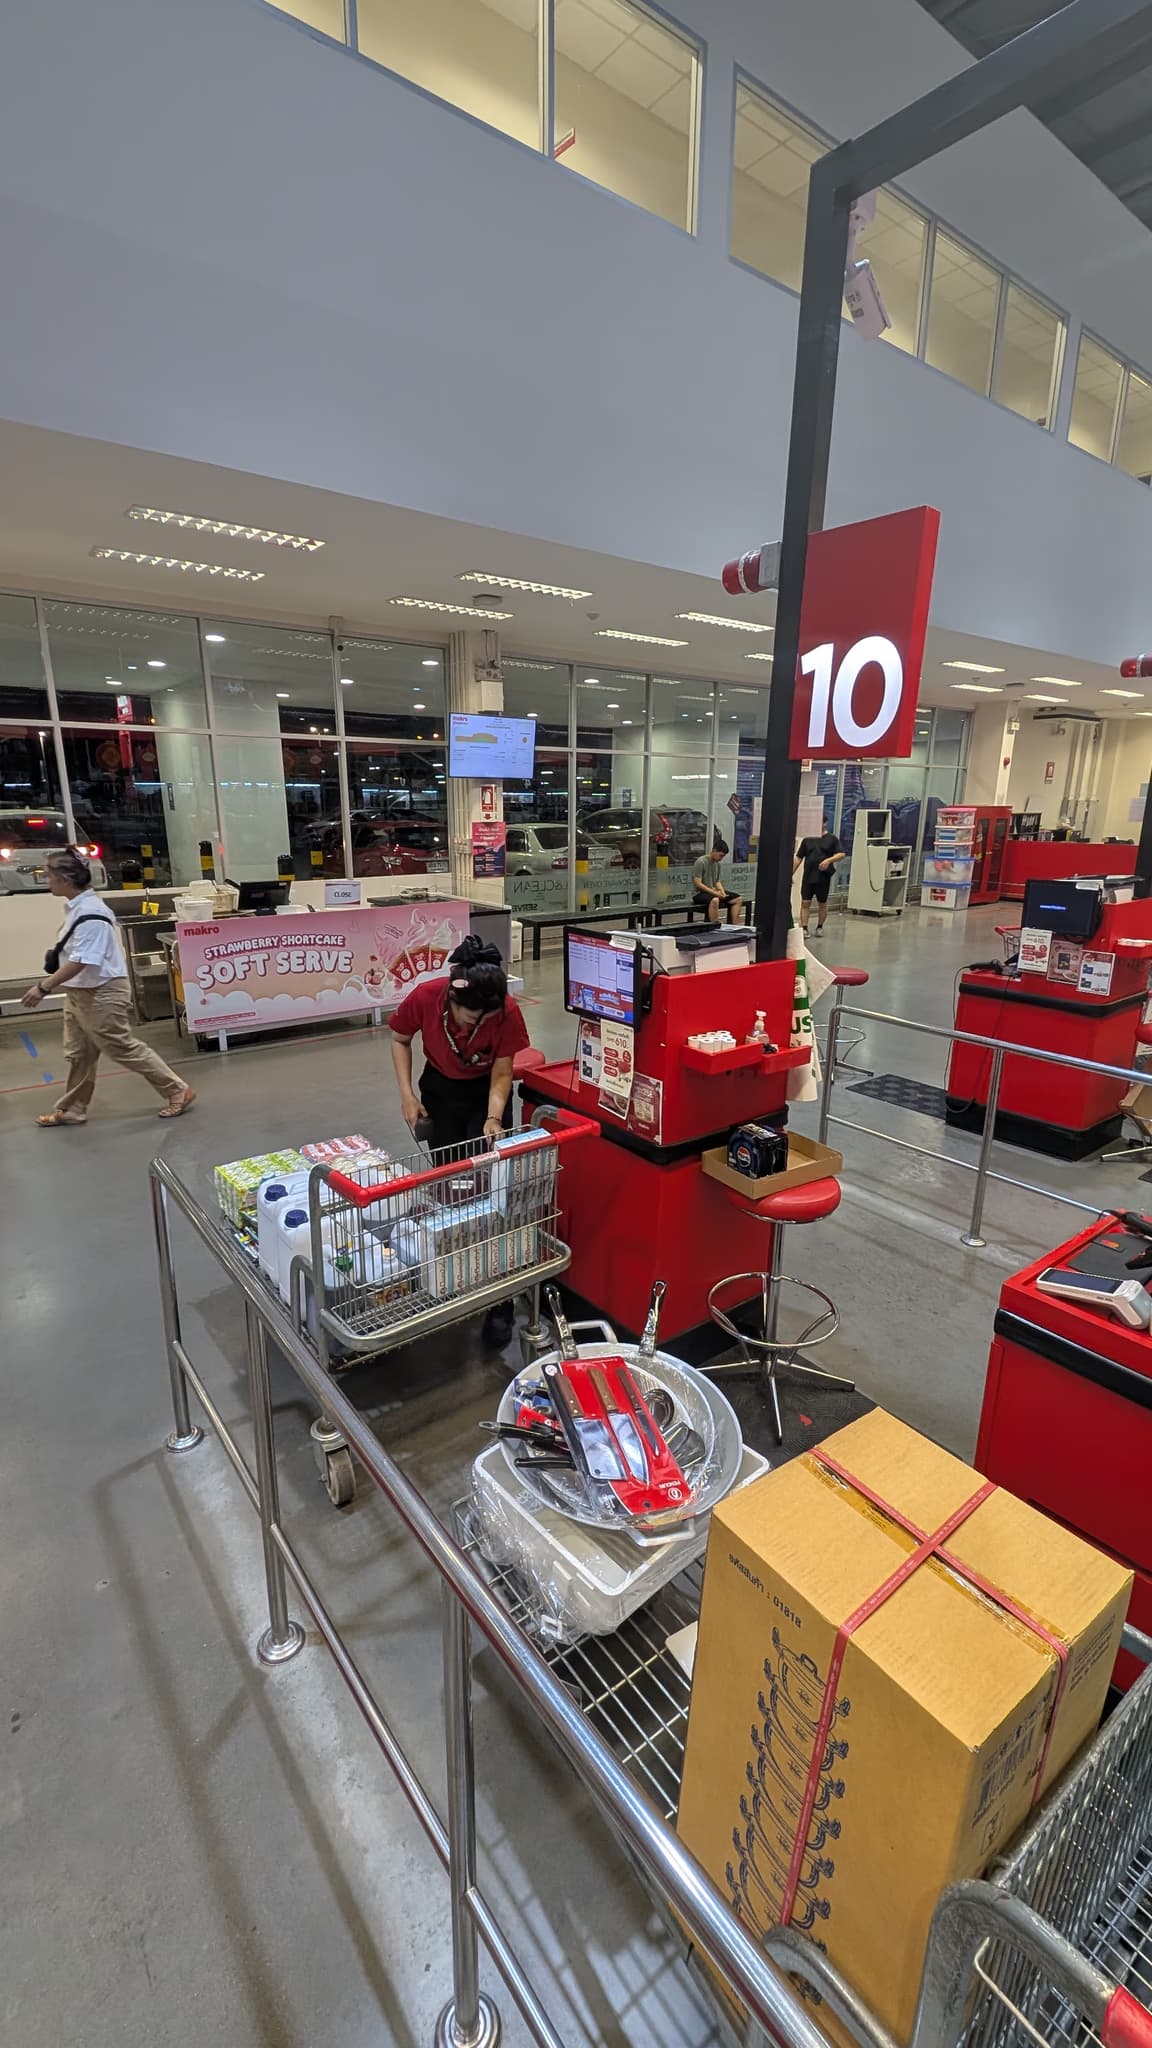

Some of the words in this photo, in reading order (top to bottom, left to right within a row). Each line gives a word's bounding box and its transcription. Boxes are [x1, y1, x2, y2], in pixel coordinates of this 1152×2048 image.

[800, 635, 904, 748] 10
[183, 925, 220, 937] makro
[204, 936, 280, 960] STRAWBERRY
[281, 934, 345, 947] SHORTCAKE
[196, 952, 271, 990] SOFT
[276, 949, 354, 974] SERVE
[773, 1595, 802, 1629] 01818
